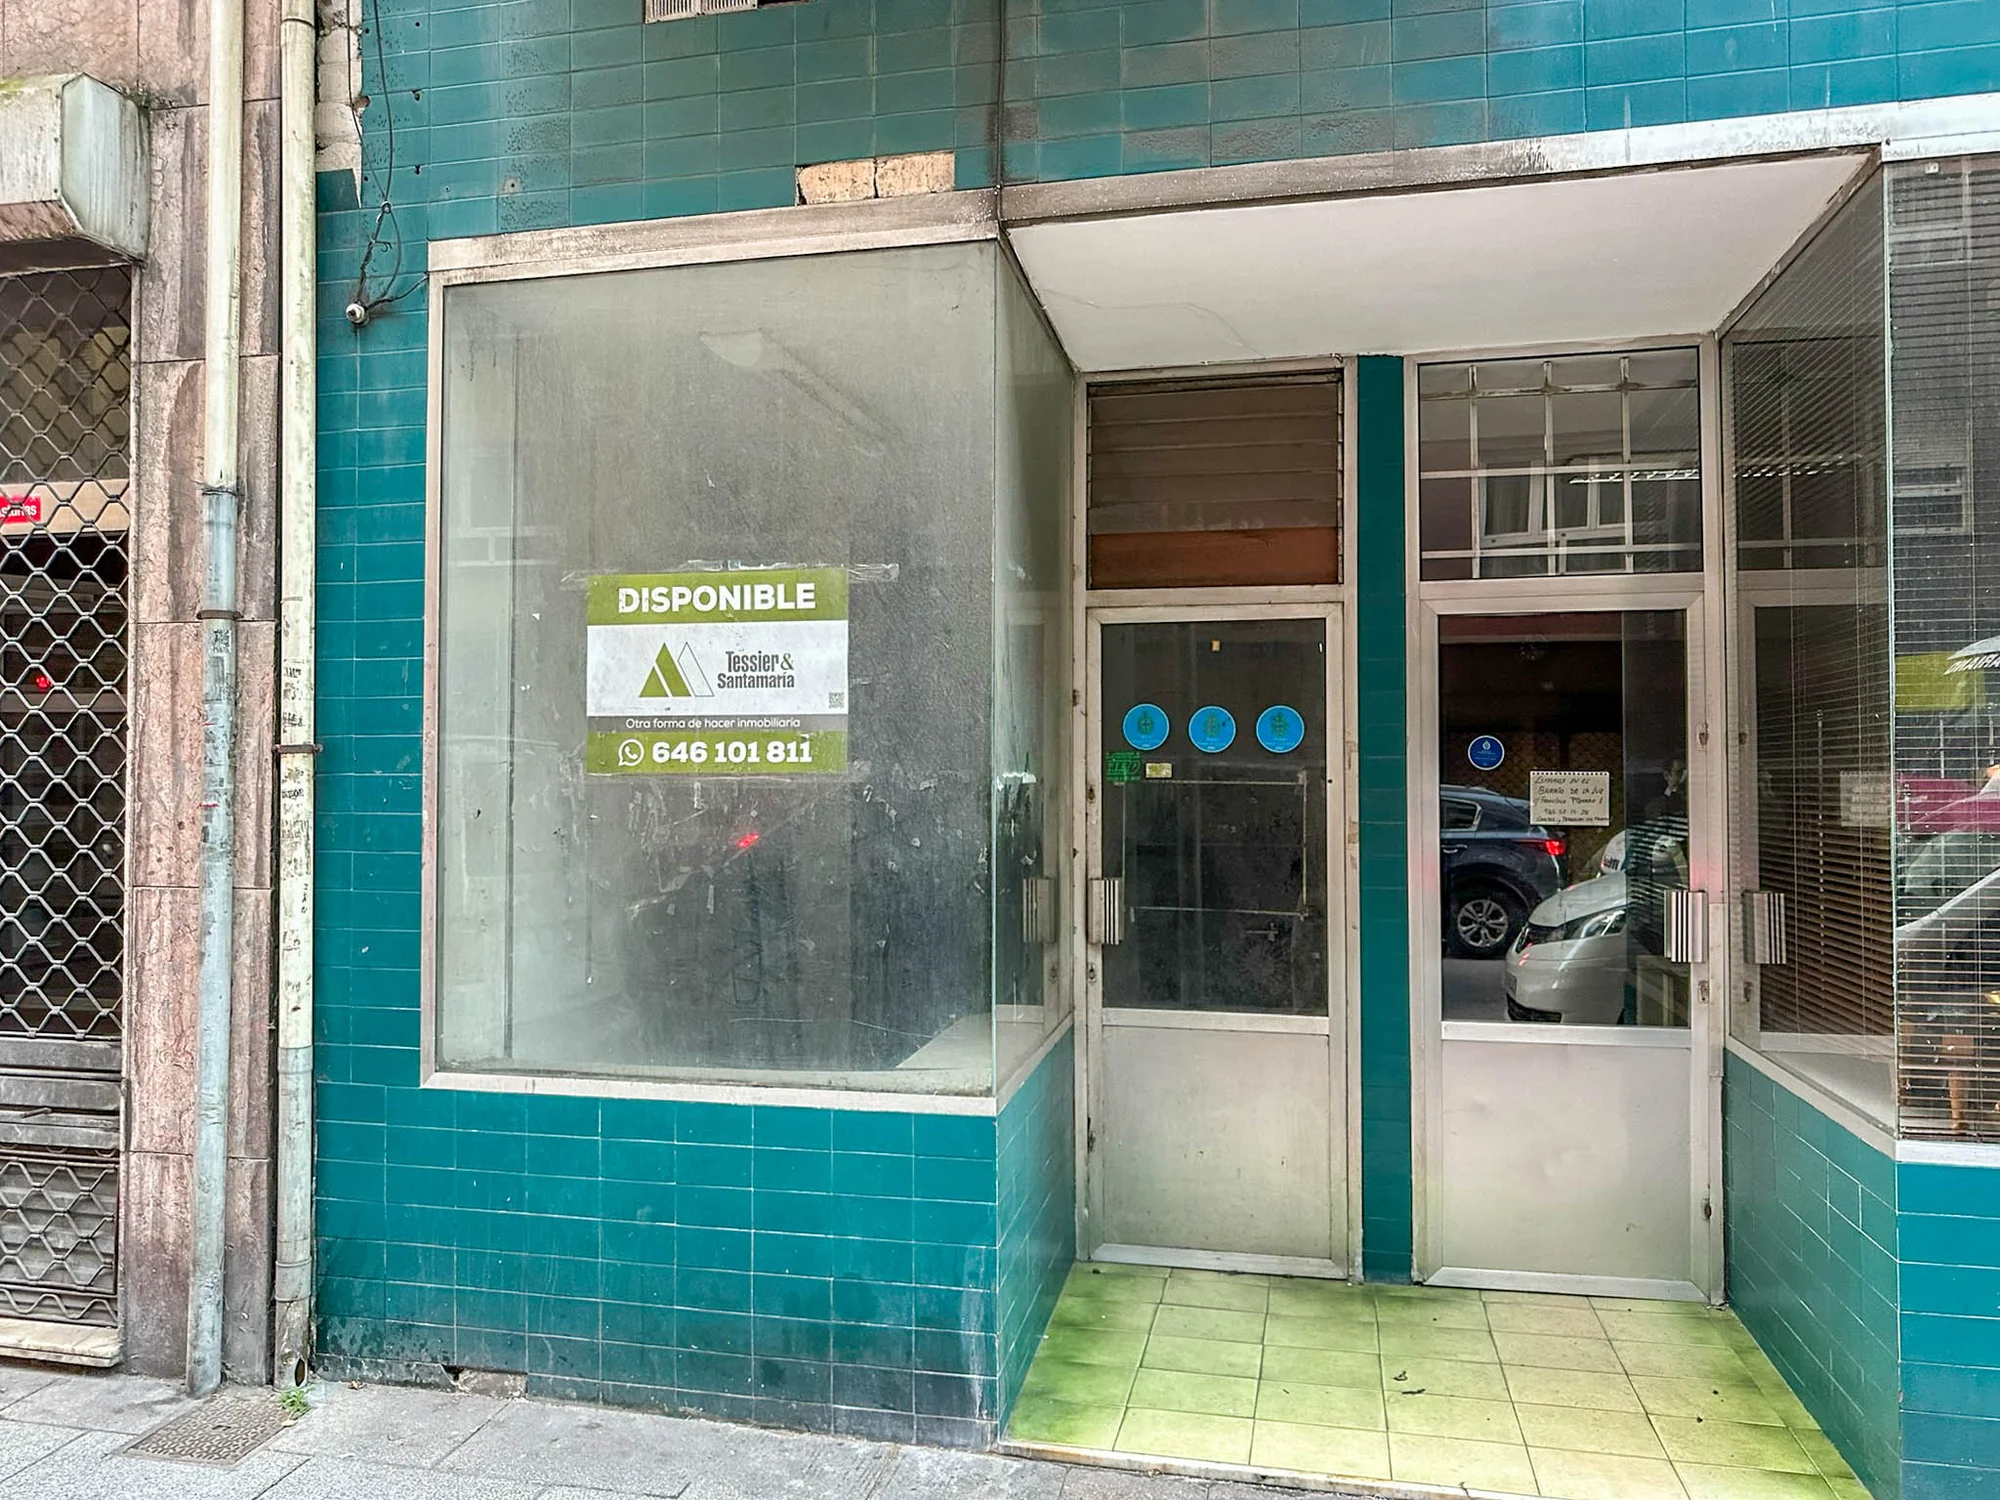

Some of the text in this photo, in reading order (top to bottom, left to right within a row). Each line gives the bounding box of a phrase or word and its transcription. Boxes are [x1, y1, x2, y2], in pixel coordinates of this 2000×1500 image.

[618, 582, 816, 613] DISPONIBLE
[717, 672, 795, 689] Santamaría
[625, 717, 801, 729] Otra forma de hacer inmobiliaria
[652, 740, 813, 763] 646 101 811
